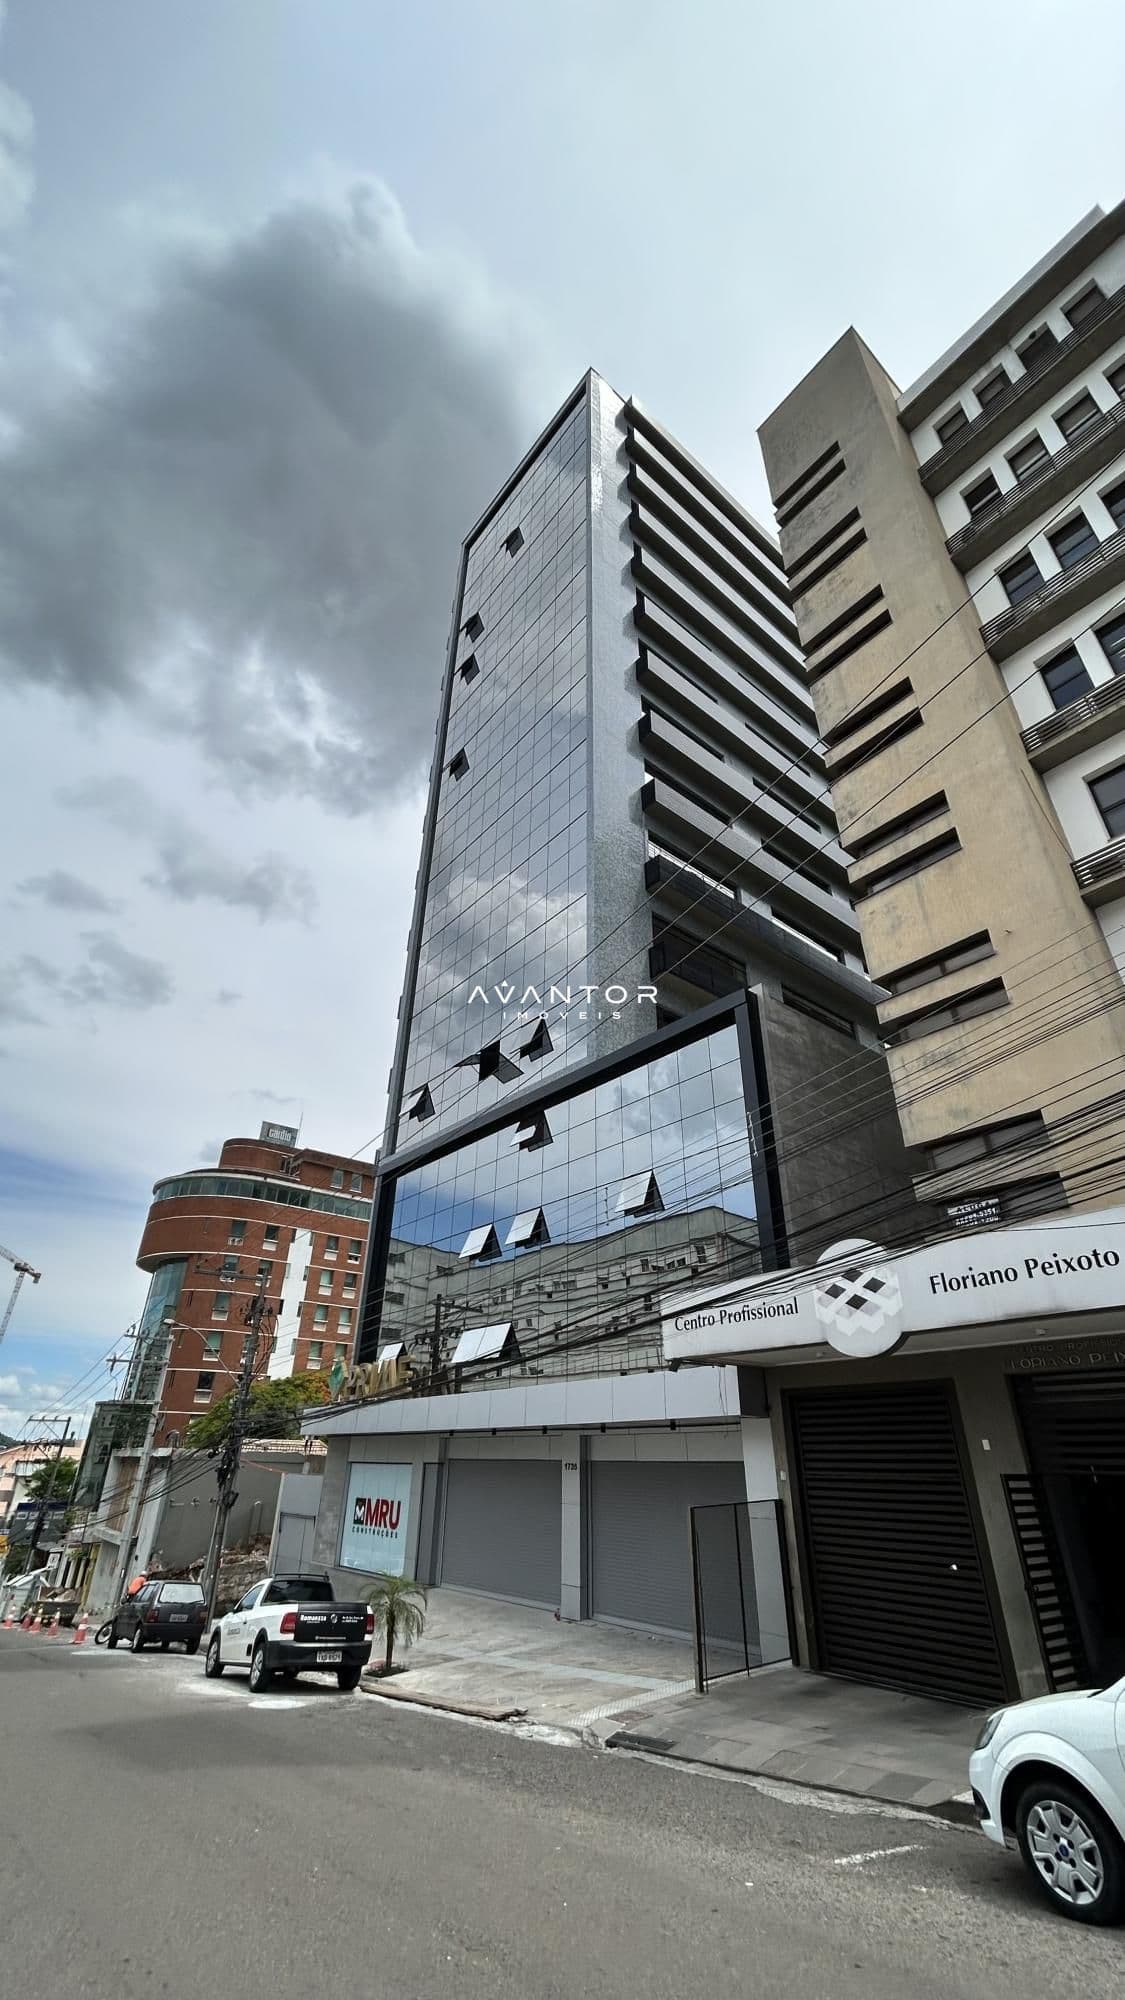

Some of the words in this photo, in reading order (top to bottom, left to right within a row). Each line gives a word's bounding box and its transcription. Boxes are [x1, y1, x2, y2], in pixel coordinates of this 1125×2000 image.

[929, 1266, 1018, 1294] Floriano
[1024, 1249, 1120, 1279] Peixoto
[674, 1314, 715, 1331] Centro
[720, 1296, 799, 1325] Profissional
[364, 1498, 401, 1530] MRU
